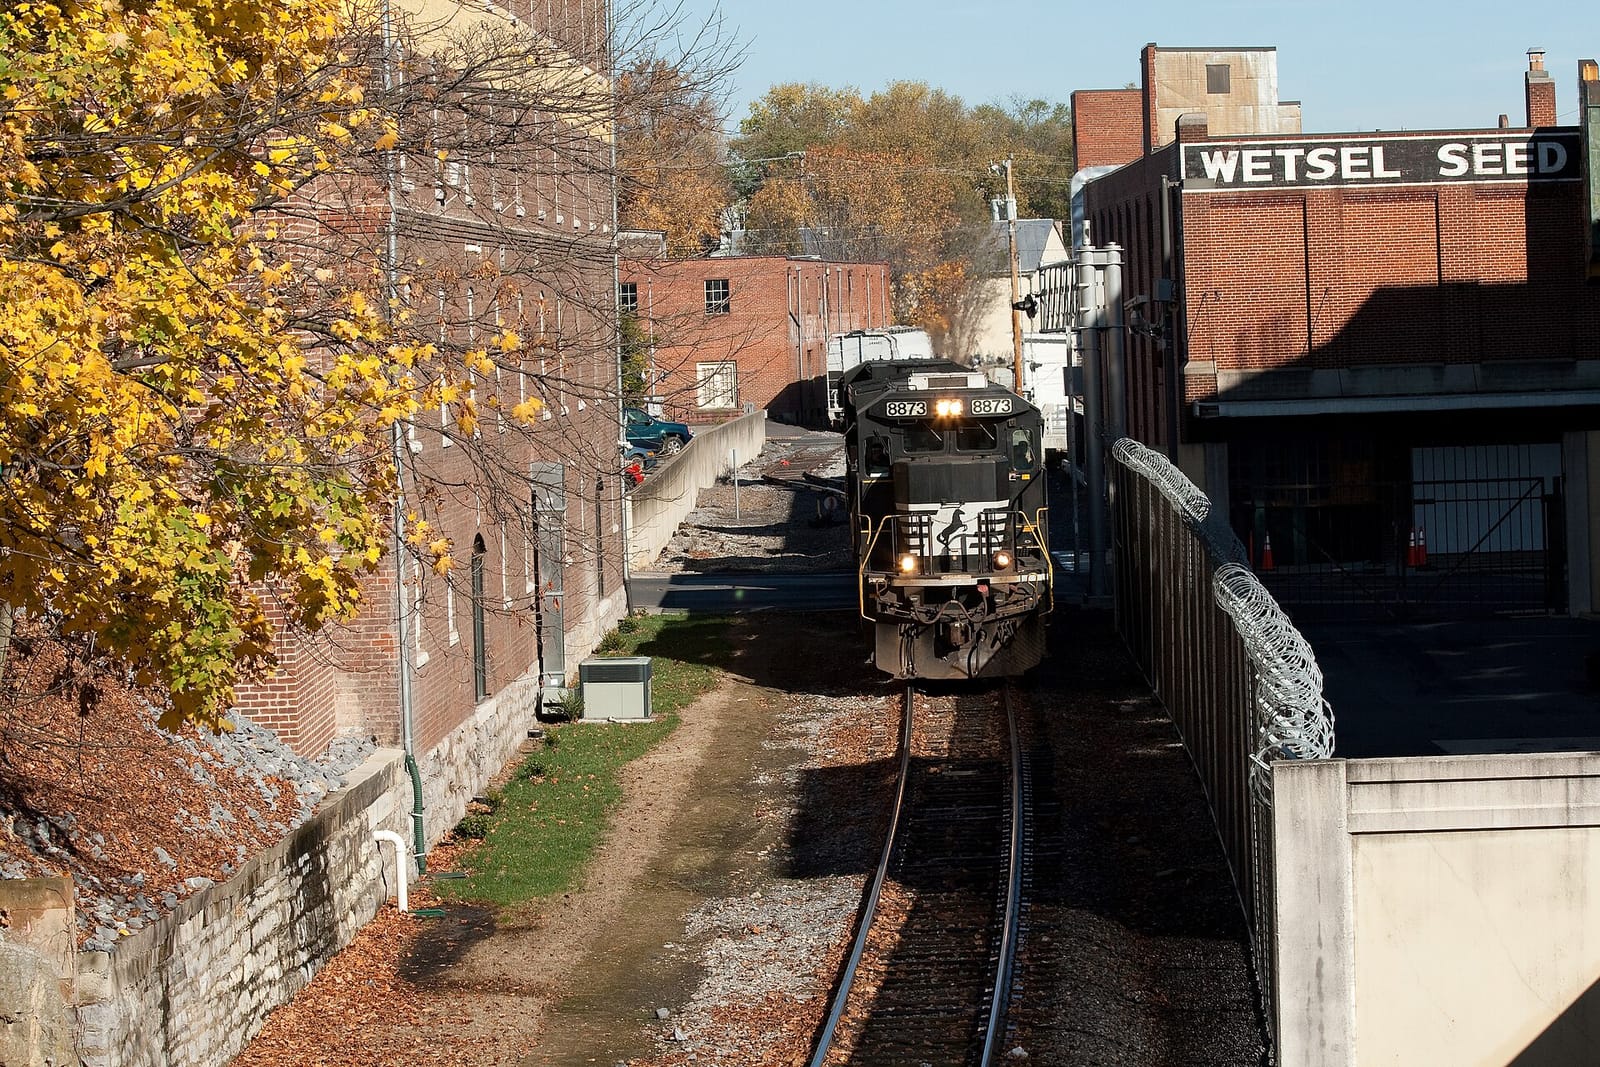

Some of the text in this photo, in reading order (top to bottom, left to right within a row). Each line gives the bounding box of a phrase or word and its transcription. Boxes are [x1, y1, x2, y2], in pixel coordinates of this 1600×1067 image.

[1199, 141, 1568, 183] WETSEL SEED
[887, 402, 926, 416] 8873
[973, 399, 1011, 414] 8873
